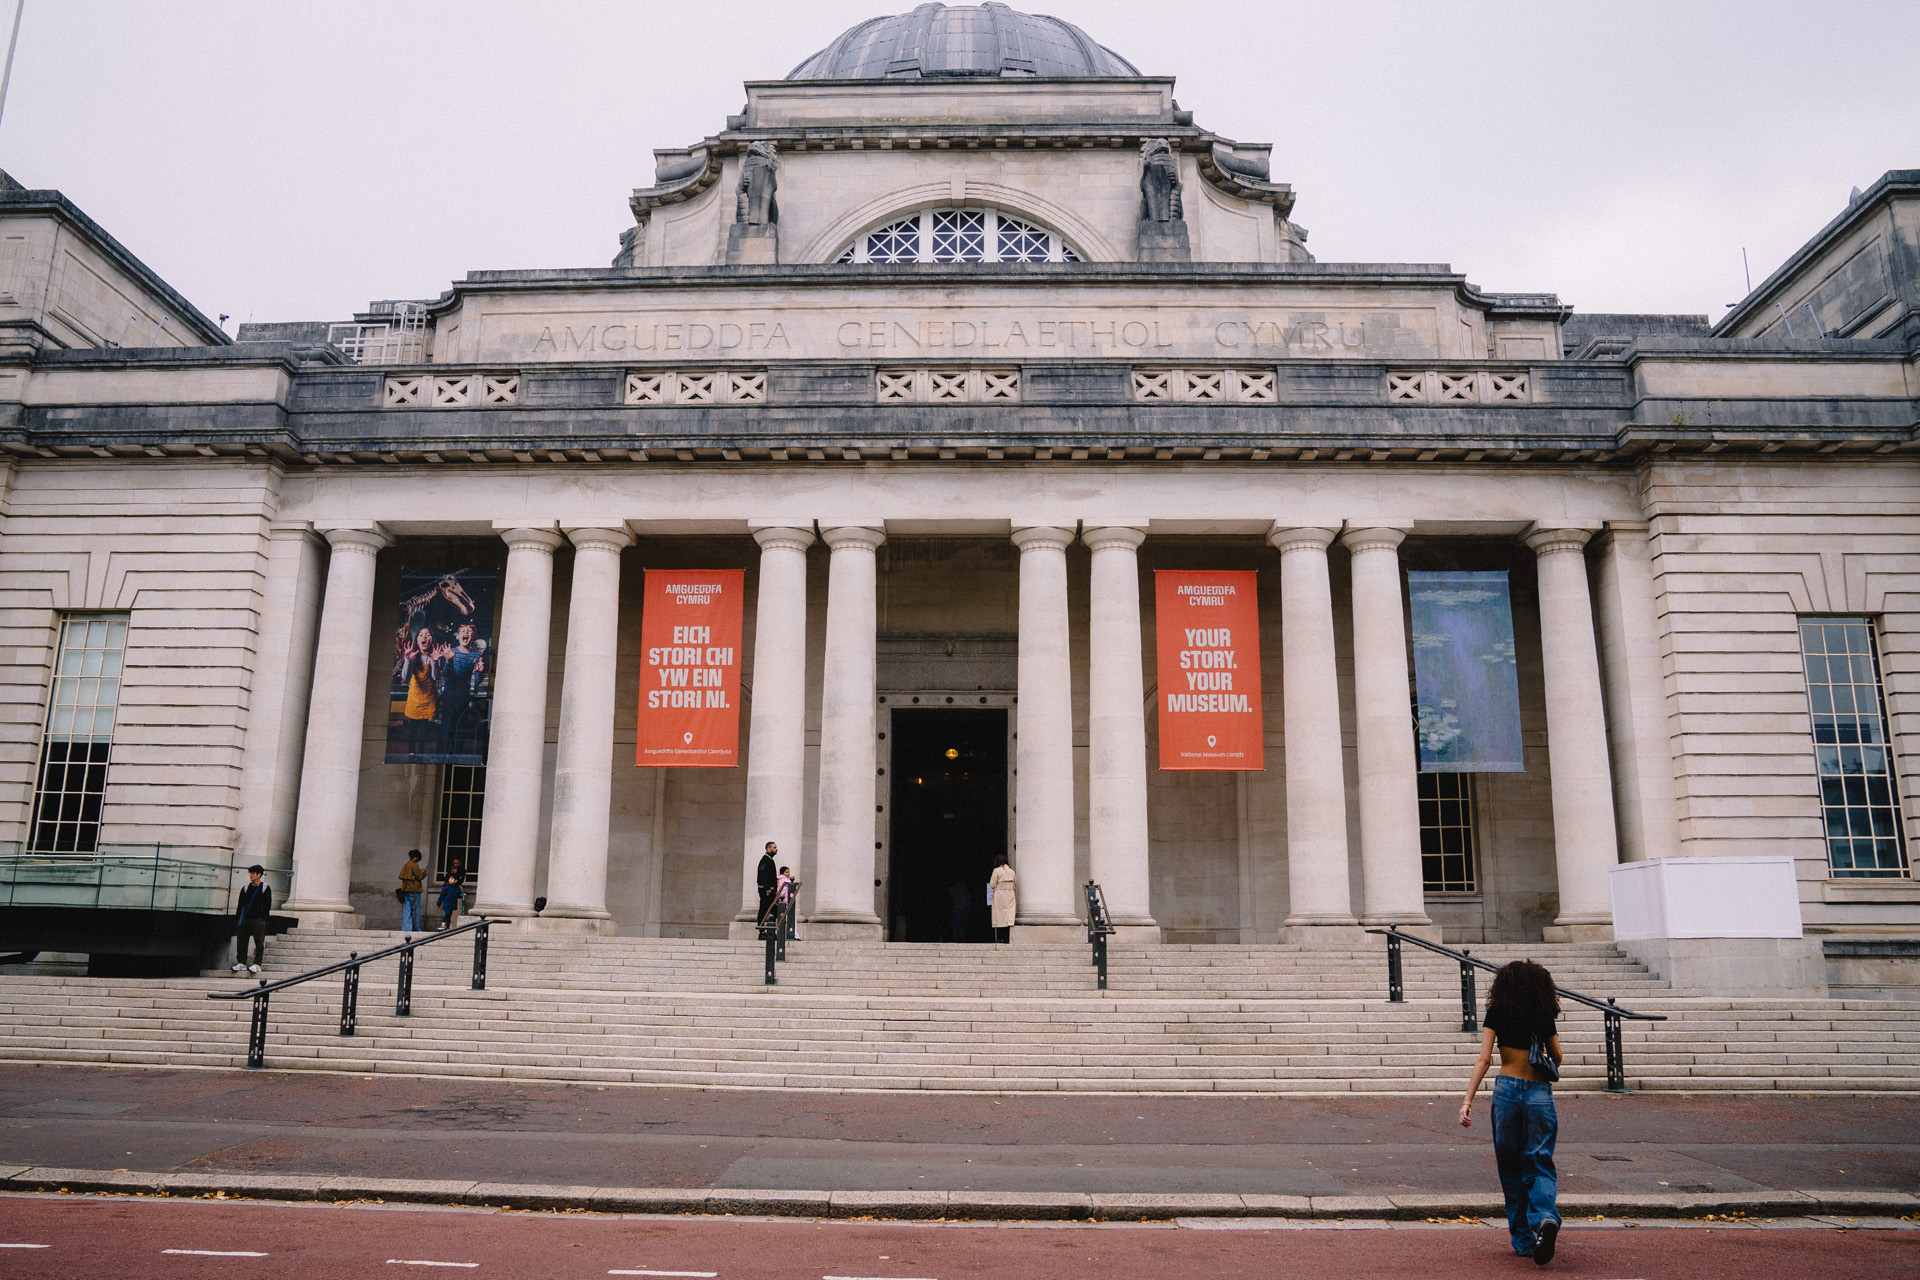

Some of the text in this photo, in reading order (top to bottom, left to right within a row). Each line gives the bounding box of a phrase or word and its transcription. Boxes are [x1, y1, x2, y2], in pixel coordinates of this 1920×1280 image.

[532, 320, 1367, 353] AMGUEDDFA GENEDLAETHOL CYMRU
[665, 584, 722, 594] AMGUEDDFA
[1177, 586, 1236, 595] AMGUEDDFA
[676, 595, 710, 604] CYMRU
[1189, 596, 1224, 606] CYMRU
[673, 626, 710, 644] EICH
[1185, 629, 1231, 647] YOUR
[649, 648, 733, 665] STORI CHI
[1180, 651, 1237, 669] STORY.
[659, 669, 722, 687] YW EIN
[1186, 672, 1232, 690] YOUR
[648, 690, 730, 708] STORI NI.
[1168, 694, 1253, 712] MUSEUM.
